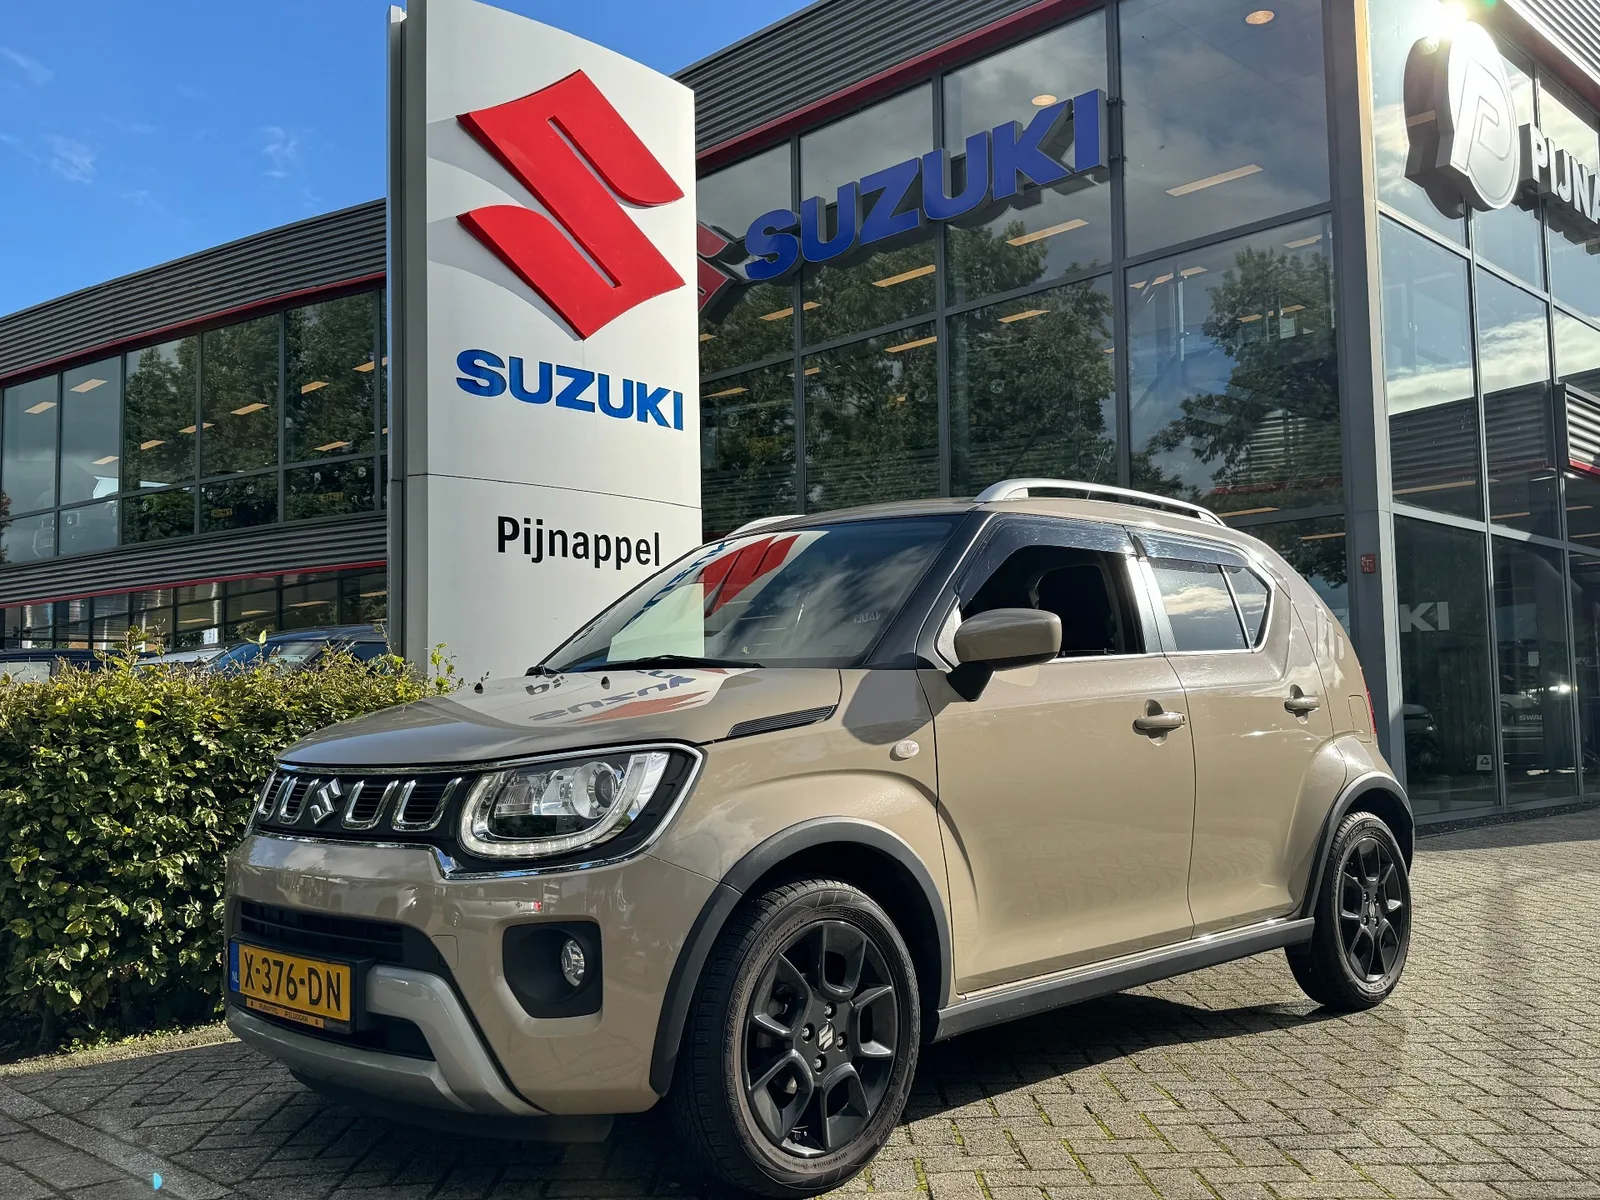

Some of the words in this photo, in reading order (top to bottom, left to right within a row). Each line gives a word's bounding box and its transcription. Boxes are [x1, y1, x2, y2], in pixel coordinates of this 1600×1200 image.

[745, 88, 1107, 281] SUZUKI
[456, 349, 684, 431] SUZUKI
[497, 516, 661, 570] Pijnappel
[244, 952, 341, 1012] X-376-DN
